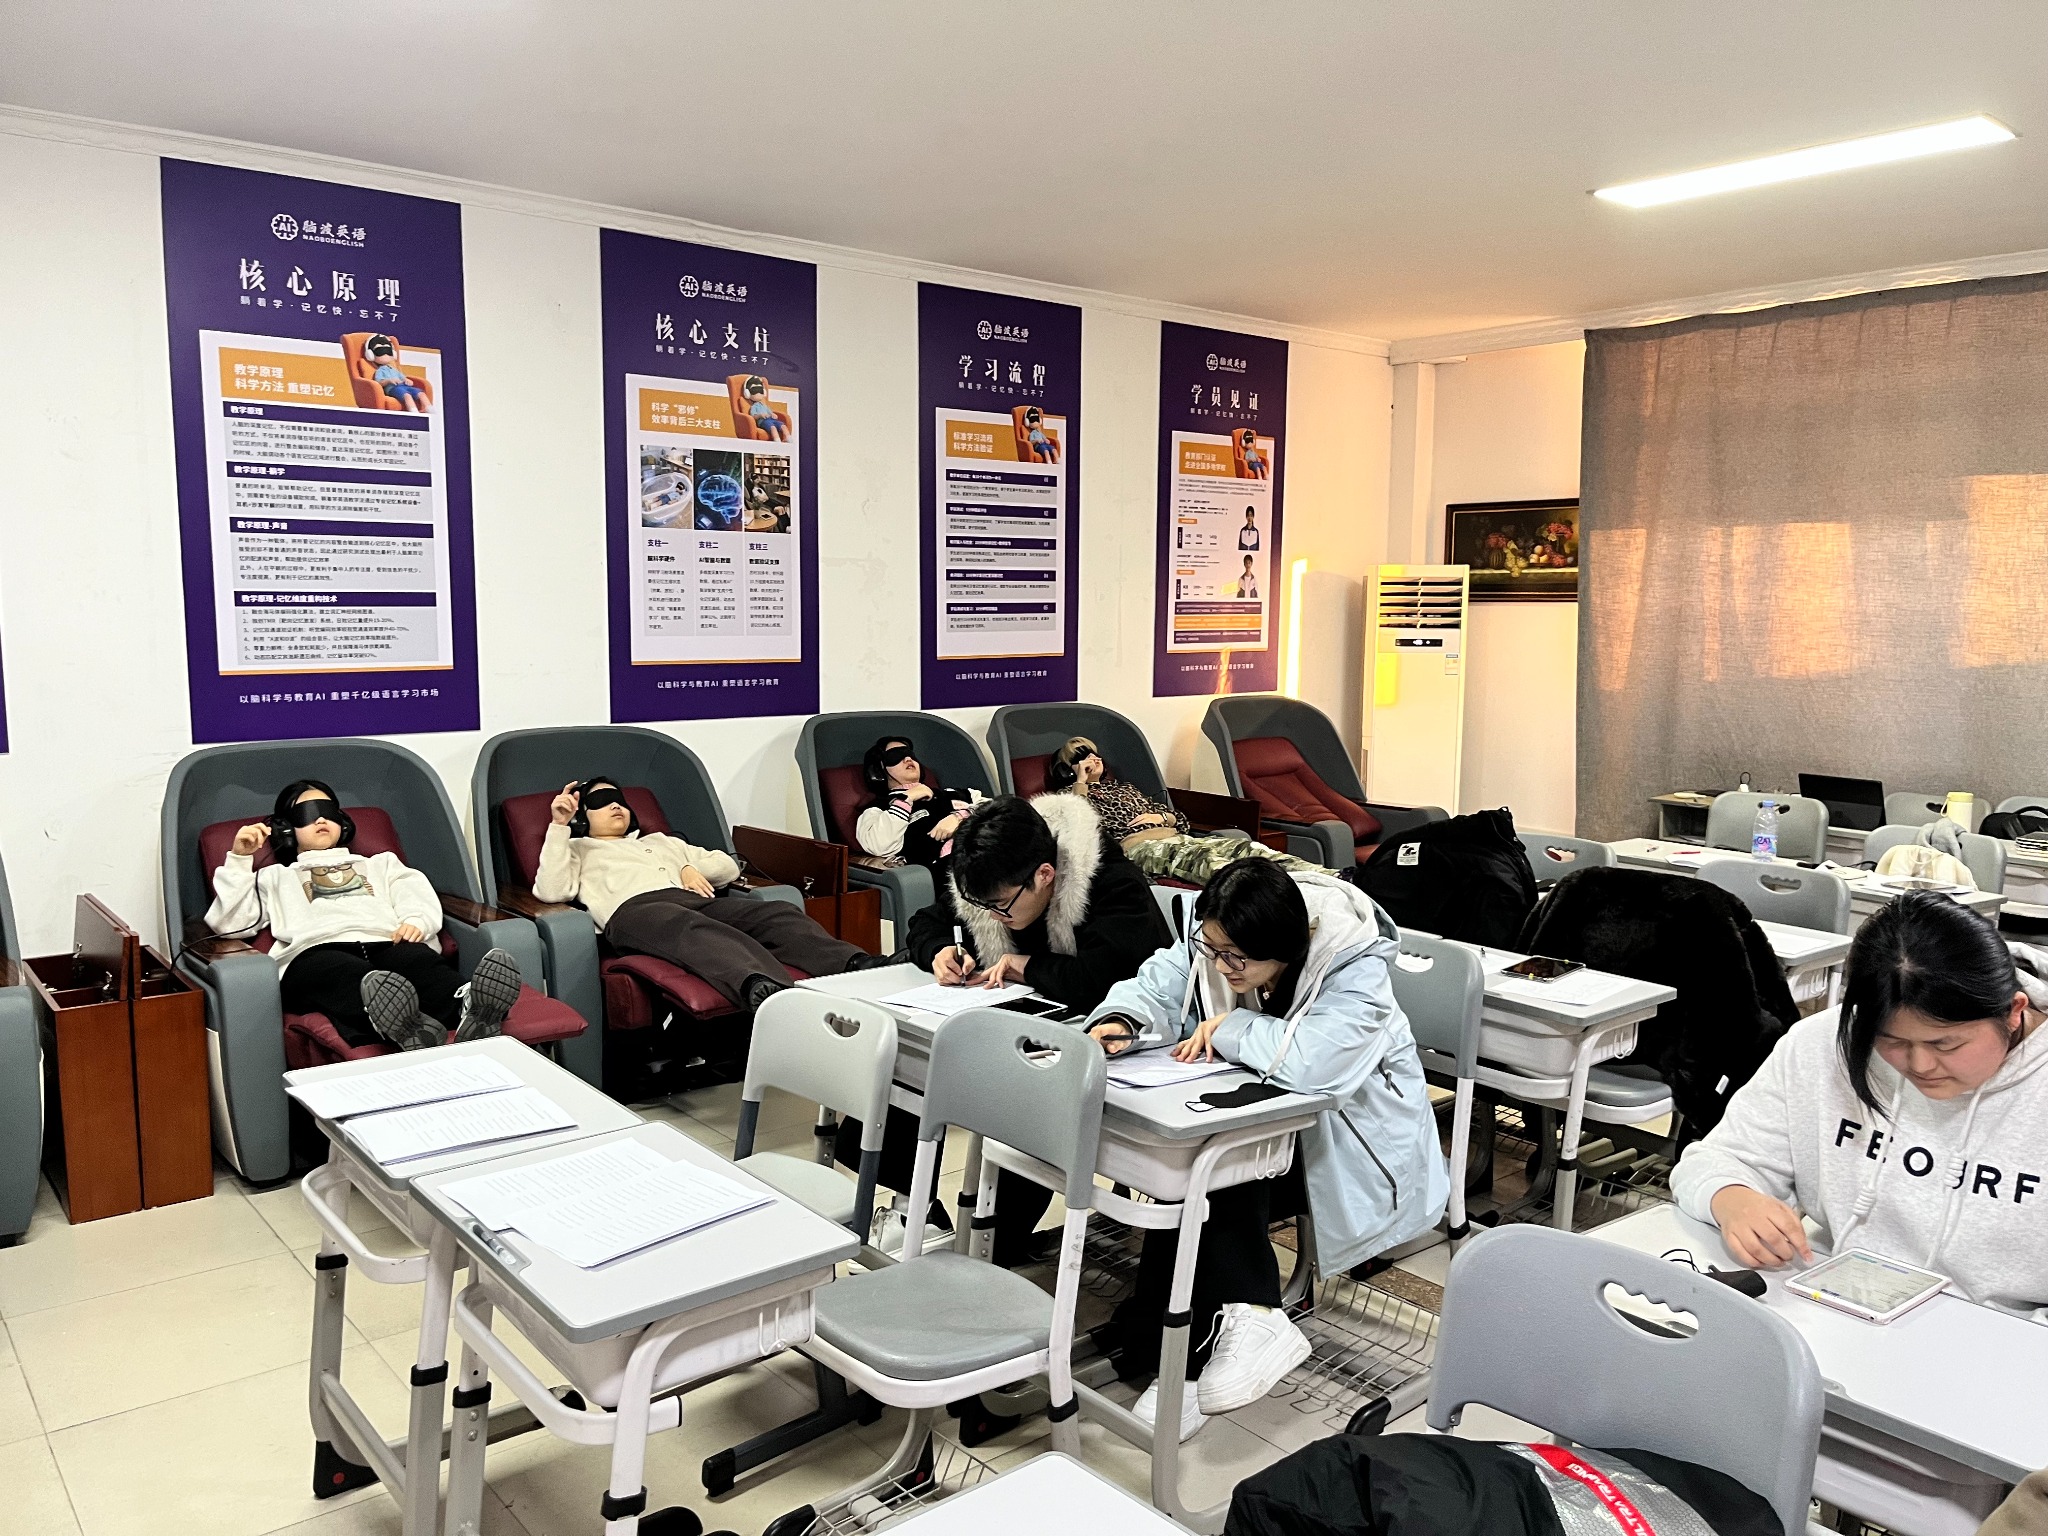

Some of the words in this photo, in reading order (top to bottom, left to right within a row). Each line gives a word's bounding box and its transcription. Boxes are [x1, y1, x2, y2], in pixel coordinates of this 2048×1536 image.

[280, 223, 291, 232] AI
[302, 219, 367, 241] 脑波英语
[302, 234, 365, 248] NAOBOENGLISH
[239, 257, 401, 308] 核心原理
[702, 280, 748, 297] 脑波英语
[655, 313, 771, 353] 核心支柱
[994, 324, 1030, 338] 脑波英语
[234, 363, 284, 379] 教学原理
[958, 355, 1046, 387] 学习流程
[234, 378, 284, 393] 科学方法
[287, 381, 335, 397] 重塑记忆
[1190, 384, 1259, 411] 学员见证
[230, 405, 264, 416] 教学原理
[651, 413, 721, 430] 效率背后三大支柱
[953, 431, 993, 444] 标准学习流程
[953, 442, 993, 454] 科学方法验证
[647, 539, 669, 547] 支柱一
[698, 541, 719, 549] 支柱二
[748, 543, 768, 551] 支柱三
[657, 680, 719, 689] 以脑科学与教育AI
[722, 678, 779, 687] 重塑语言学习教育
[239, 692, 326, 704] 以脑科学与教育AI
[330, 688, 440, 701] 重塑千亿级语言学习市场
